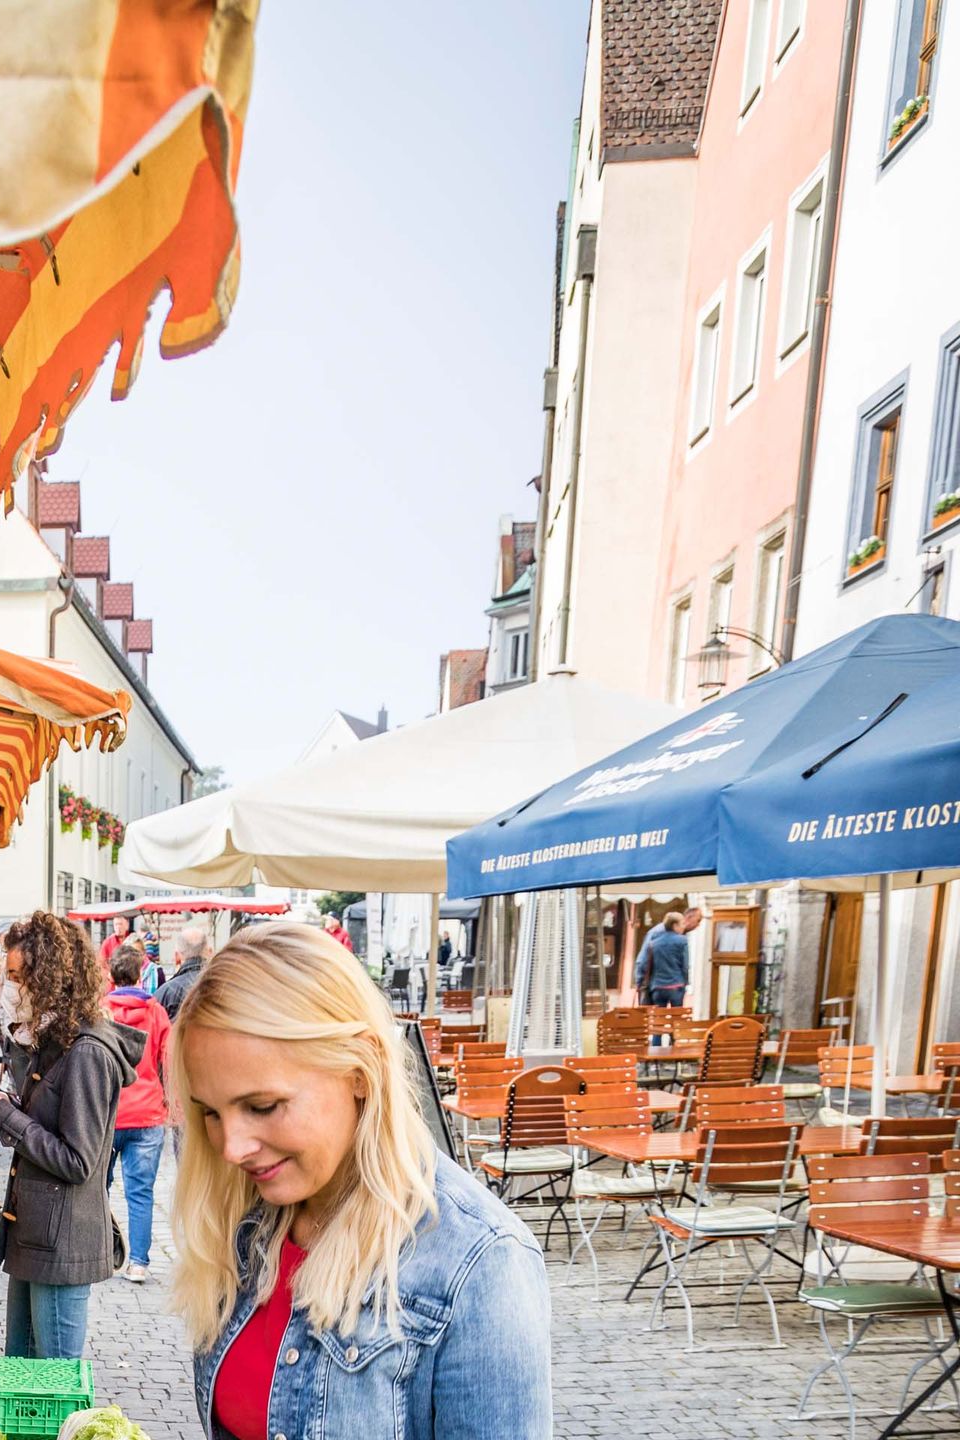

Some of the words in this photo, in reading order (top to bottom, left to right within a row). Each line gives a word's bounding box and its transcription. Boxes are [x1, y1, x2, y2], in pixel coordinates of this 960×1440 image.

[787, 820, 819, 842] DIE
[821, 810, 897, 840] ÄLTESTE
[480, 857, 497, 873] DIE
[497, 851, 531, 871] ÄLTESTE
[532, 836, 616, 864] KLOSTERBRAUEREI
[617, 833, 638, 851] DER
[640, 829, 669, 848] WELT
